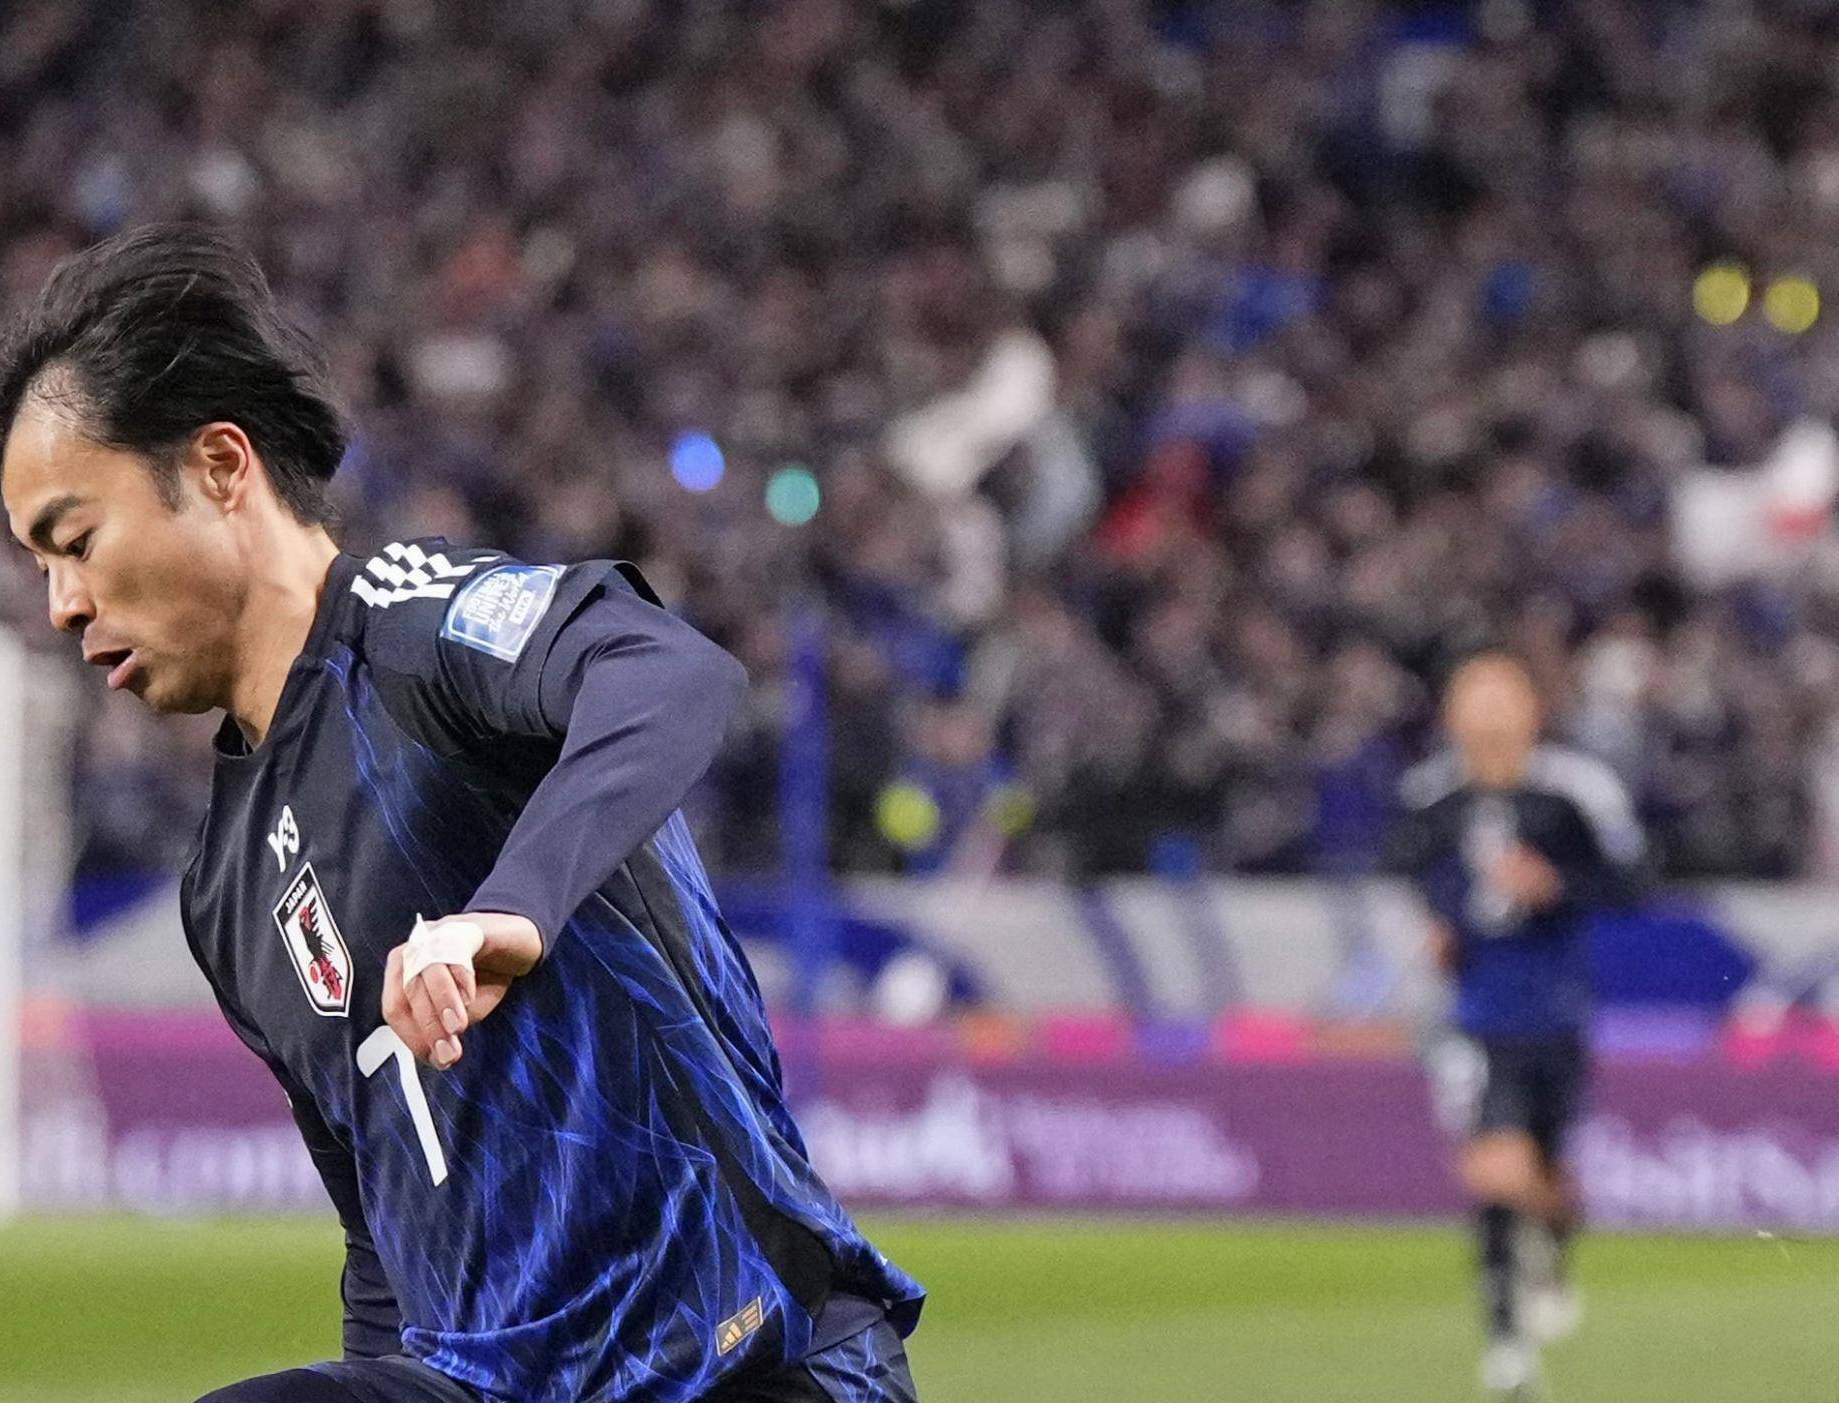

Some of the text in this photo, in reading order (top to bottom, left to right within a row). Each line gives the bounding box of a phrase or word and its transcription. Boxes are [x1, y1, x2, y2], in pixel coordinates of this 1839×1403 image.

[462, 574, 502, 618] FOOTBALL
[284, 880, 307, 914] JAPAN
[356, 1024, 449, 1187] 7
